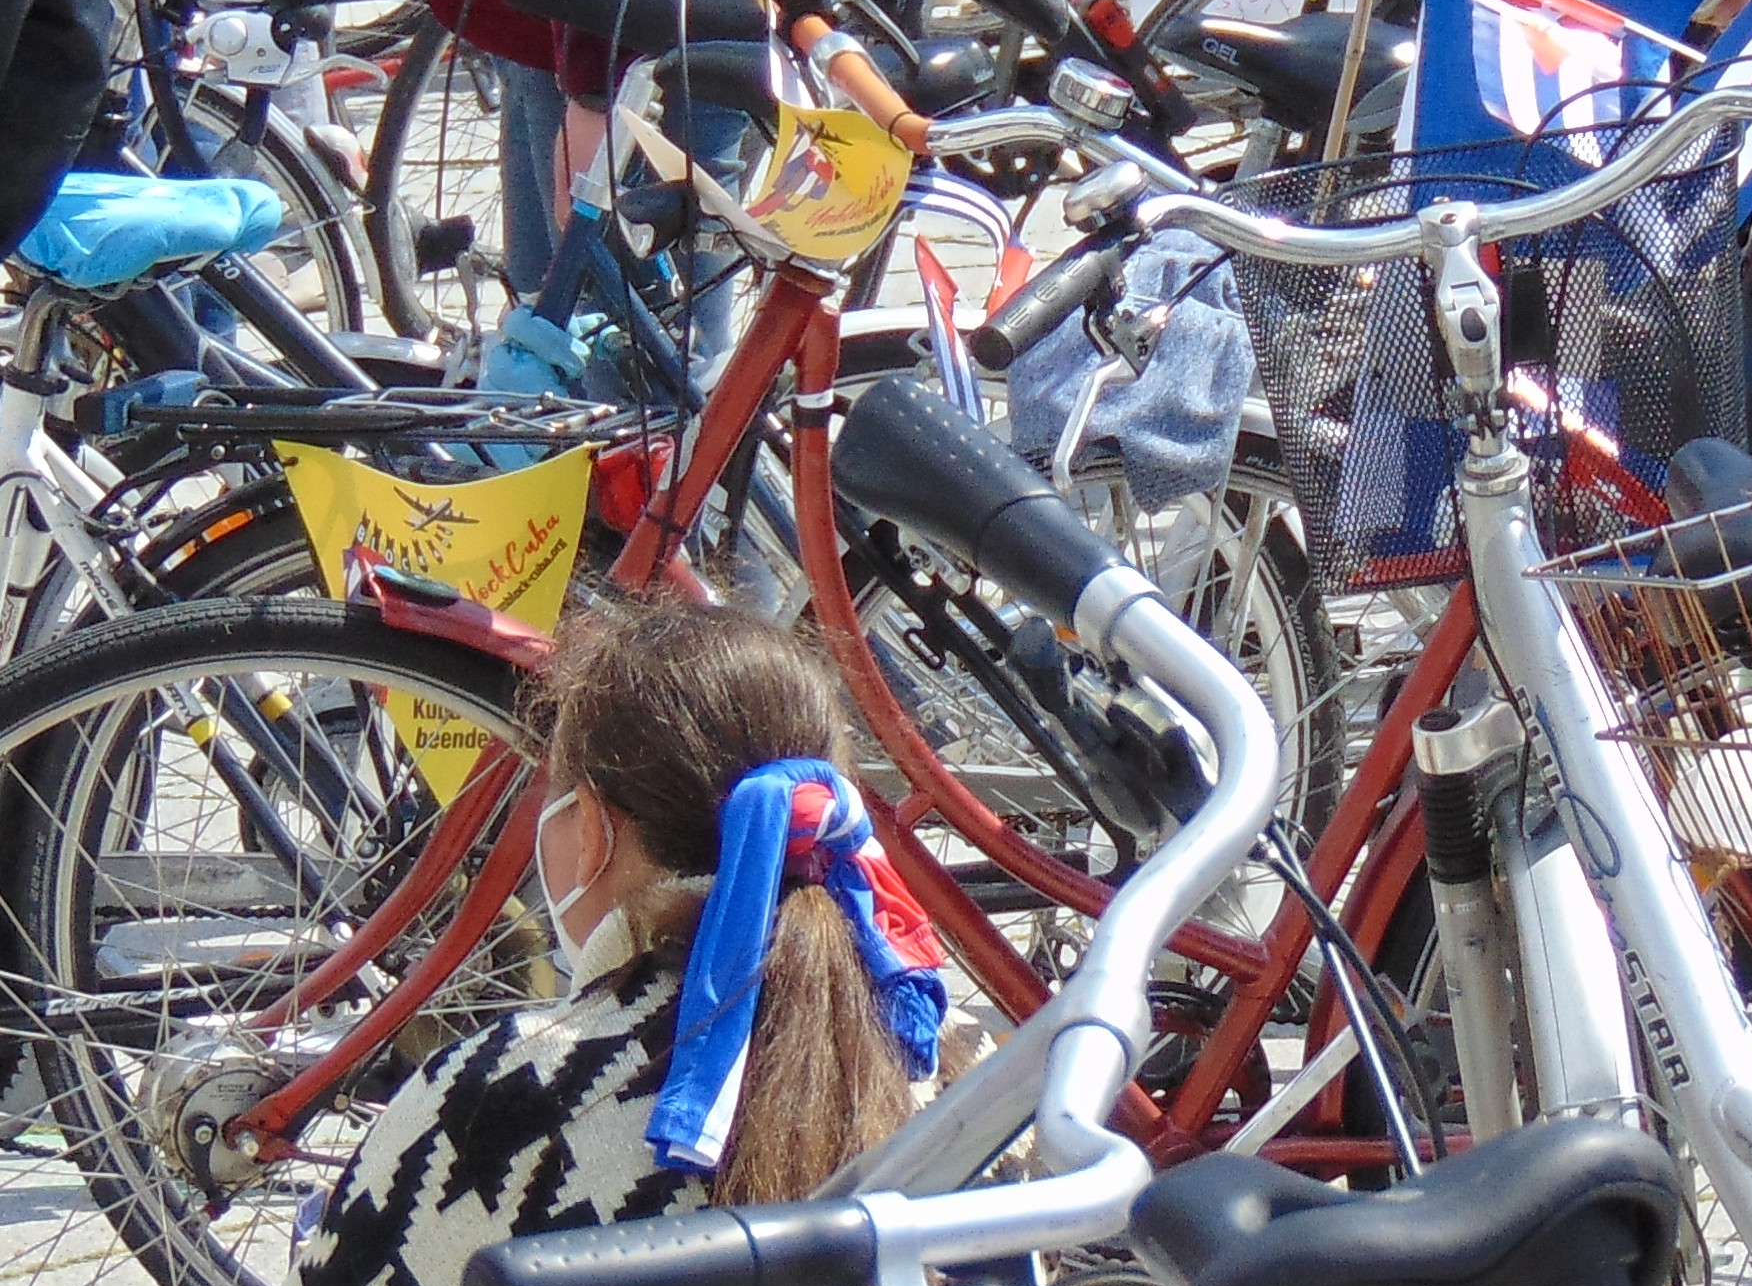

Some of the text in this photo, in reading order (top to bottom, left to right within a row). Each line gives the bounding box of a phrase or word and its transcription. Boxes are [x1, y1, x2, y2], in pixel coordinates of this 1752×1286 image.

[1202, 37, 1240, 66] GEL
[213, 258, 241, 280] 20
[1624, 948, 1693, 1090] STAR
